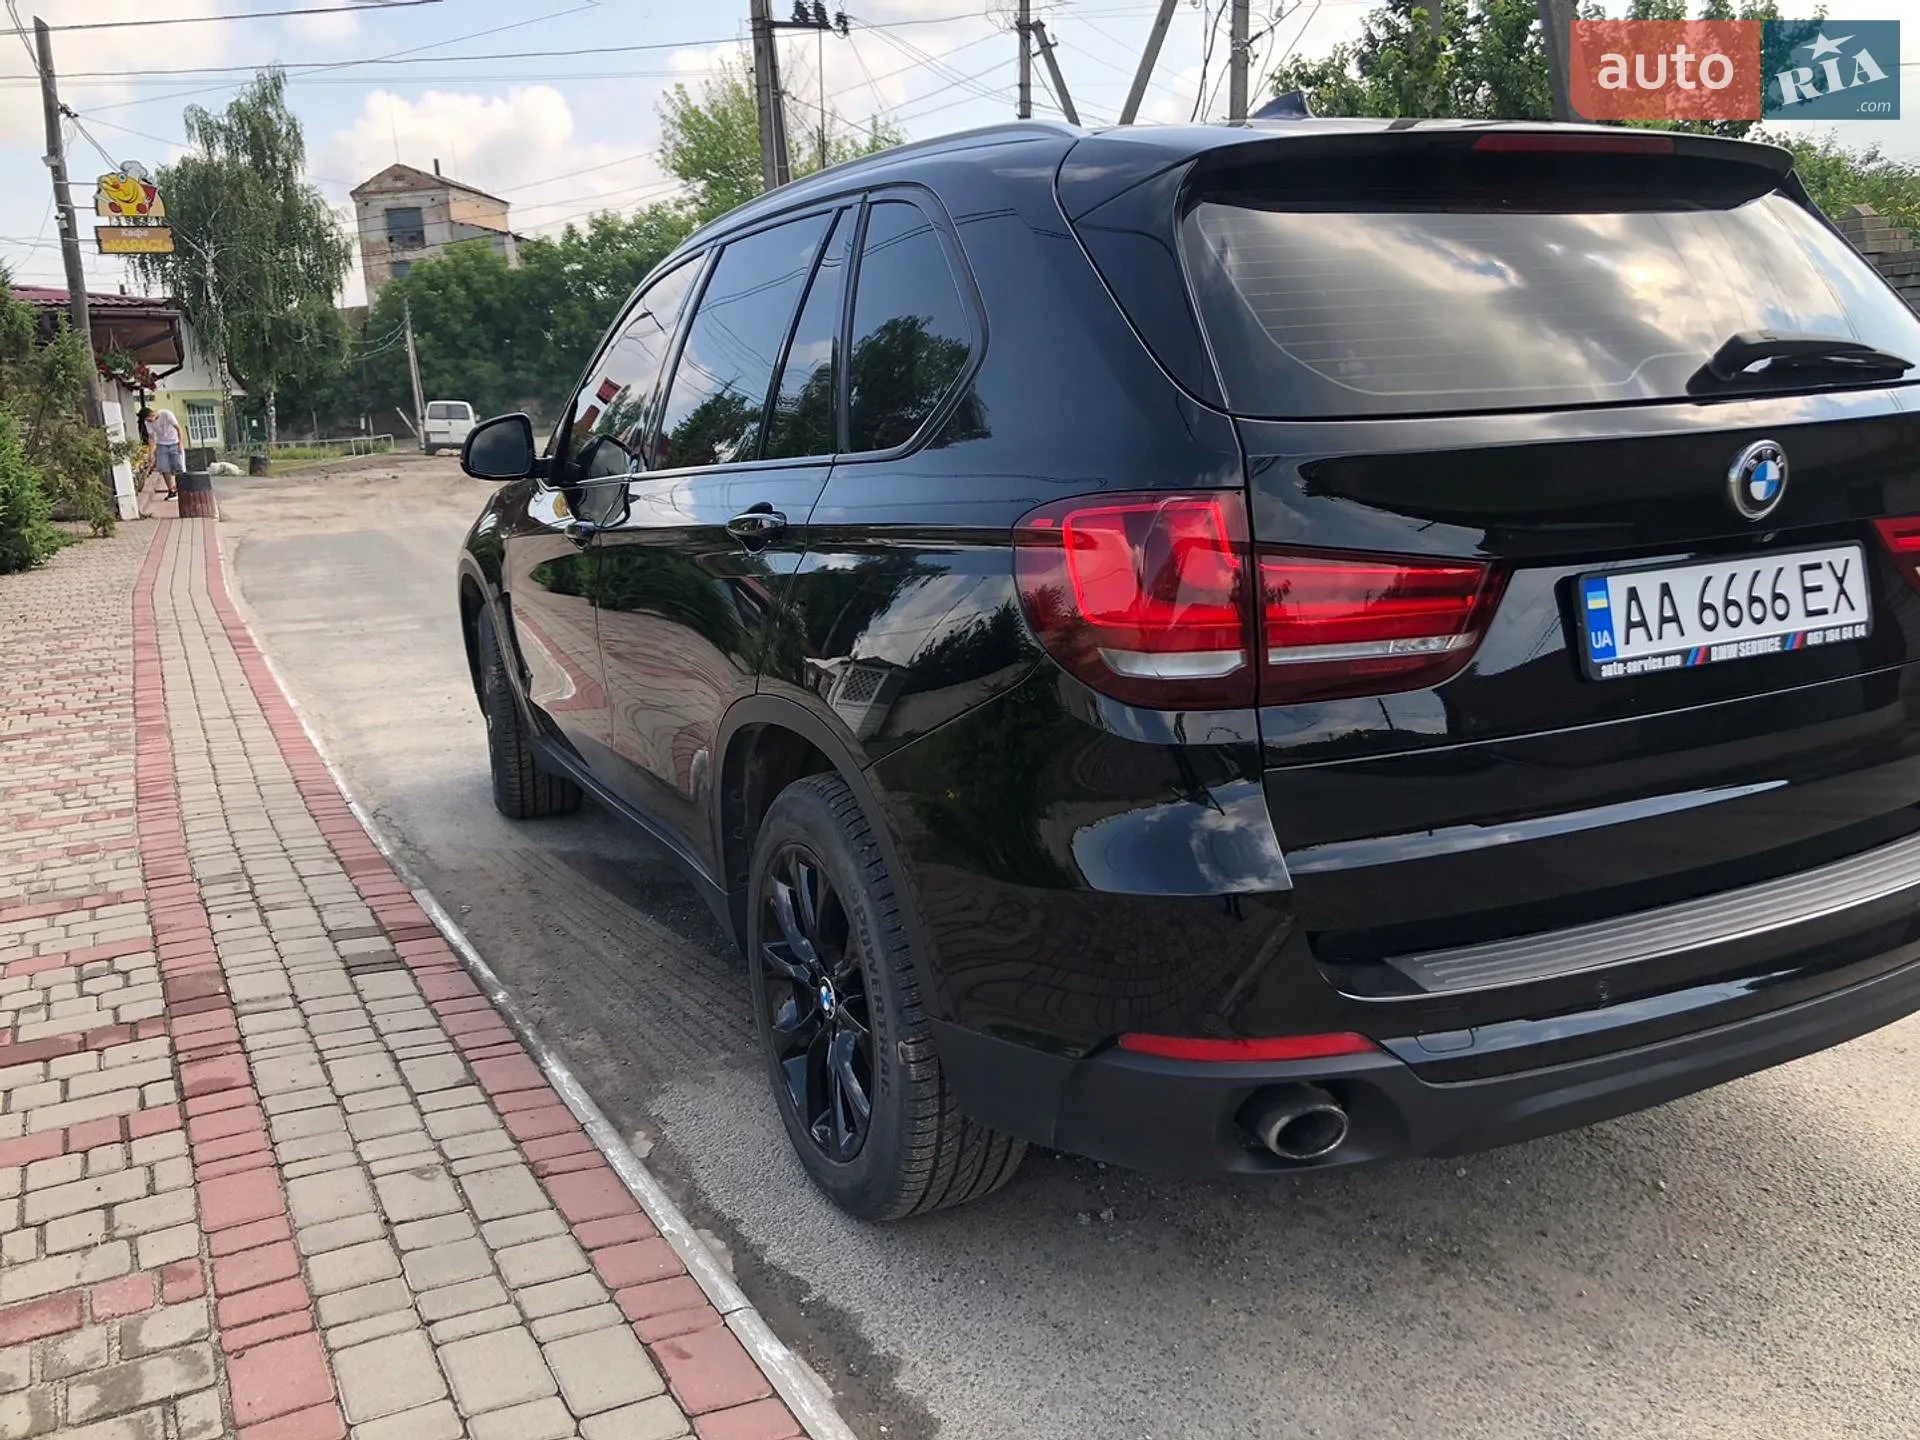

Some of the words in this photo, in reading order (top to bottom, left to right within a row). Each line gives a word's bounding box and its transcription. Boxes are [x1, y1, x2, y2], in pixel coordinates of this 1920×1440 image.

[1623, 582, 1686, 645] AA
[1698, 565, 1790, 632] 6666
[1798, 558, 1856, 618] EX
[1590, 630, 1614, 649] UA
